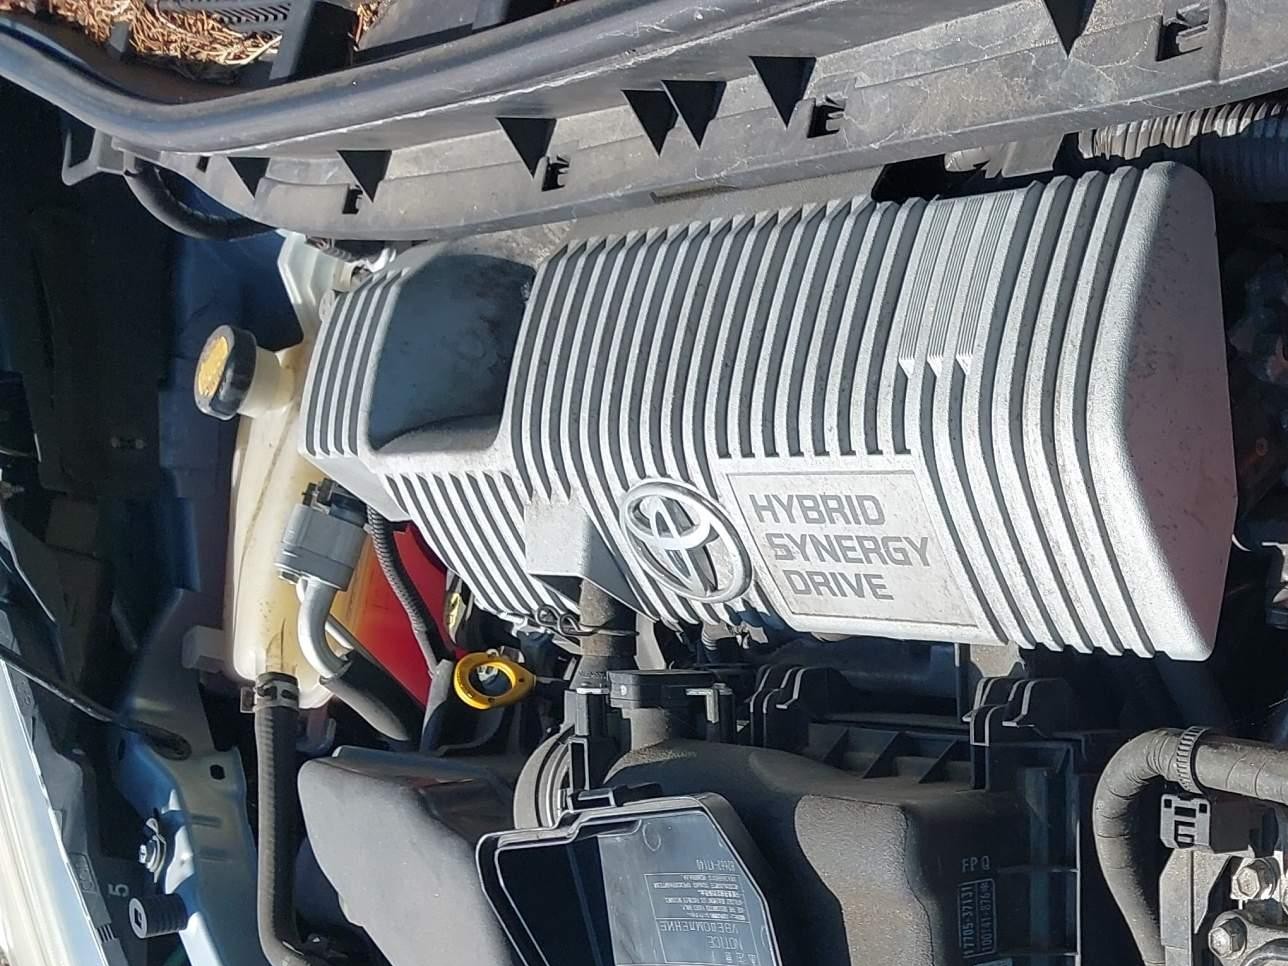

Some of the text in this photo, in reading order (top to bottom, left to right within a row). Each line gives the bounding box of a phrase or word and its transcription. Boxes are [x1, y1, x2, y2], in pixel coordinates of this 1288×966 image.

[749, 494, 886, 526] HYBRID
[765, 533, 930, 567] SYNERGY
[783, 569, 894, 600] DRIVE
